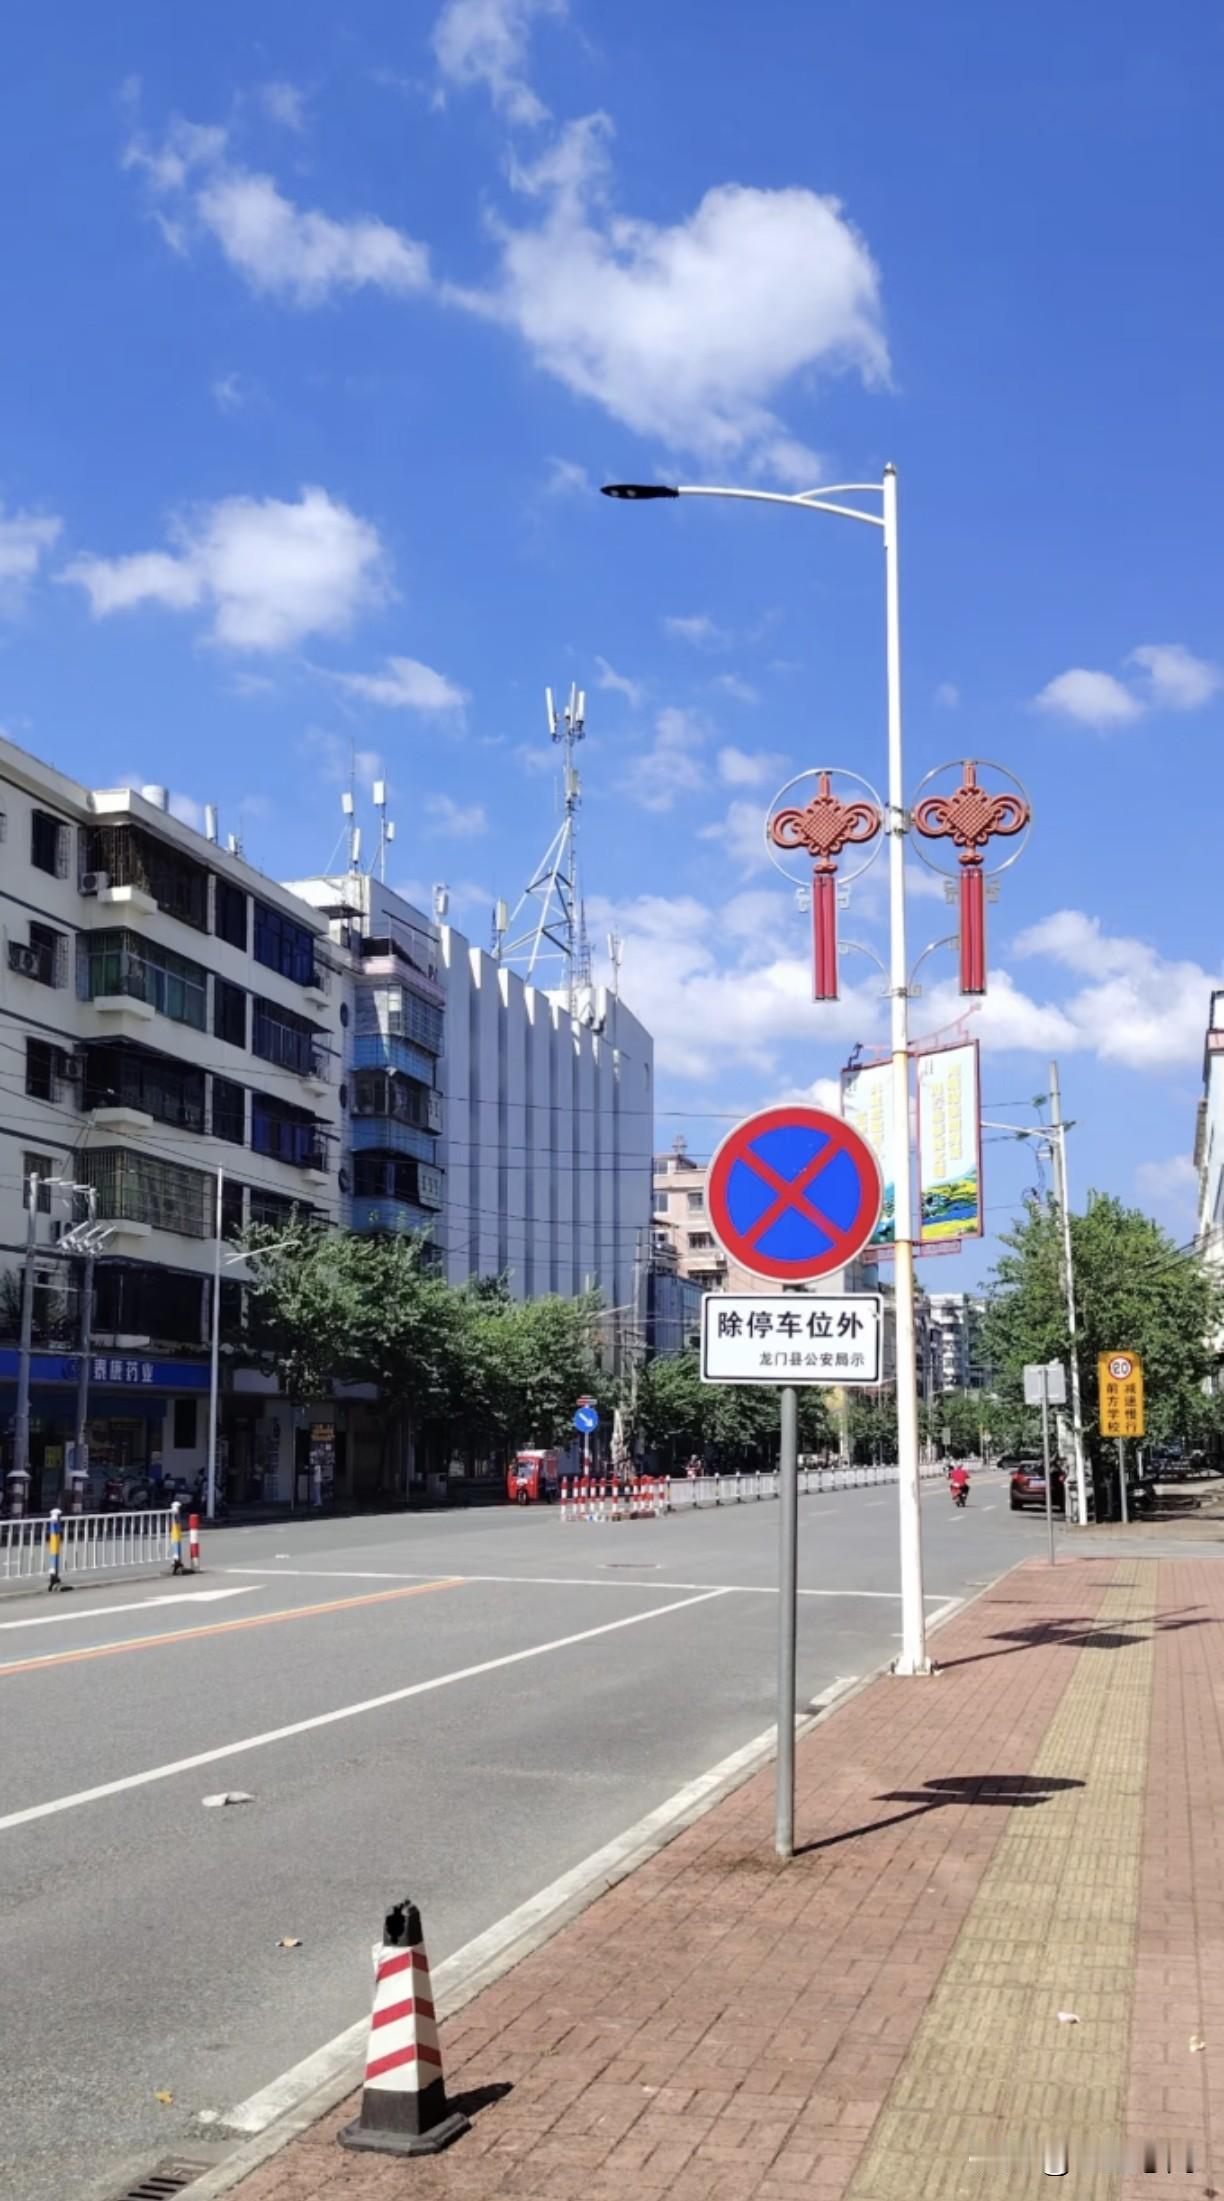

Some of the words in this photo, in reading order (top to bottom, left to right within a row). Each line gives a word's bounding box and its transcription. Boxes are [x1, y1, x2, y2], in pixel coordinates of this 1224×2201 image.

[718, 1310, 864, 1339] 除停车位外
[759, 1351, 865, 1367] 龙门县公安局示
[1113, 1362, 1129, 1374] 20
[1107, 1383, 1120, 1432] 前方学校
[1125, 1383, 1137, 1432] 减速慢行
